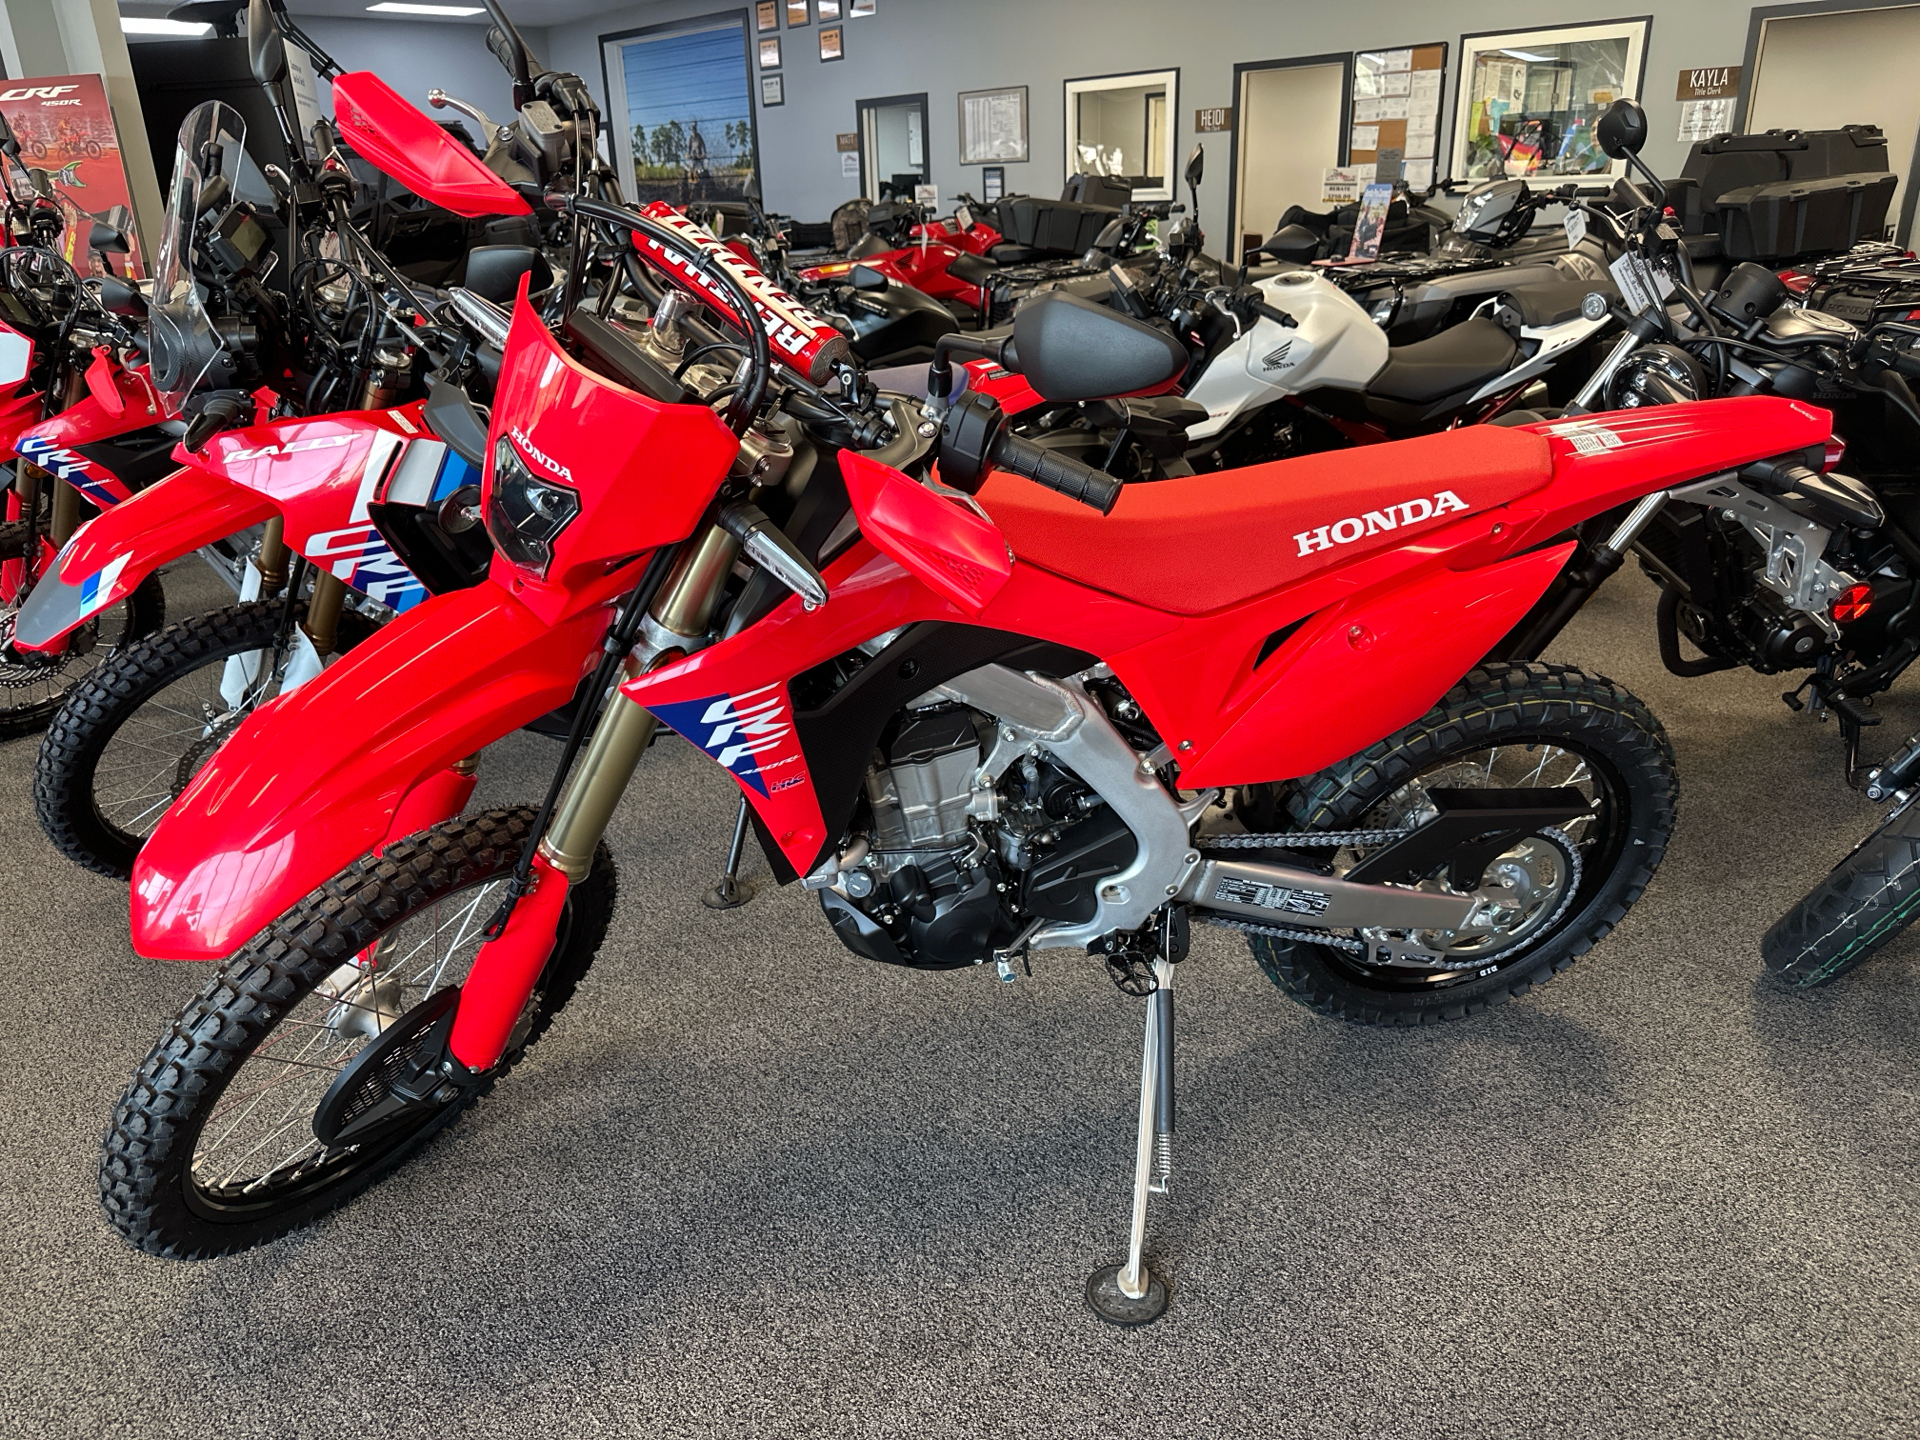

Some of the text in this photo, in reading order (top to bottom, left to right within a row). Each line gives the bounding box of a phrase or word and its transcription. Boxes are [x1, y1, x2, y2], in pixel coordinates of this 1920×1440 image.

[1690, 68, 1728, 88] KAYLA
[0, 85, 79, 101] CRF
[41, 99, 83, 107] 450R
[1201, 109, 1225, 127] HEIDI
[660, 203, 830, 328] RENTHAL
[1826, 303, 1870, 315] HONDA
[1263, 362, 1295, 372] HONDA
[222, 433, 362, 464] RALLY
[511, 425, 574, 483] HONDA
[1293, 490, 1470, 557] HONDA
[700, 680, 791, 767] CRF
